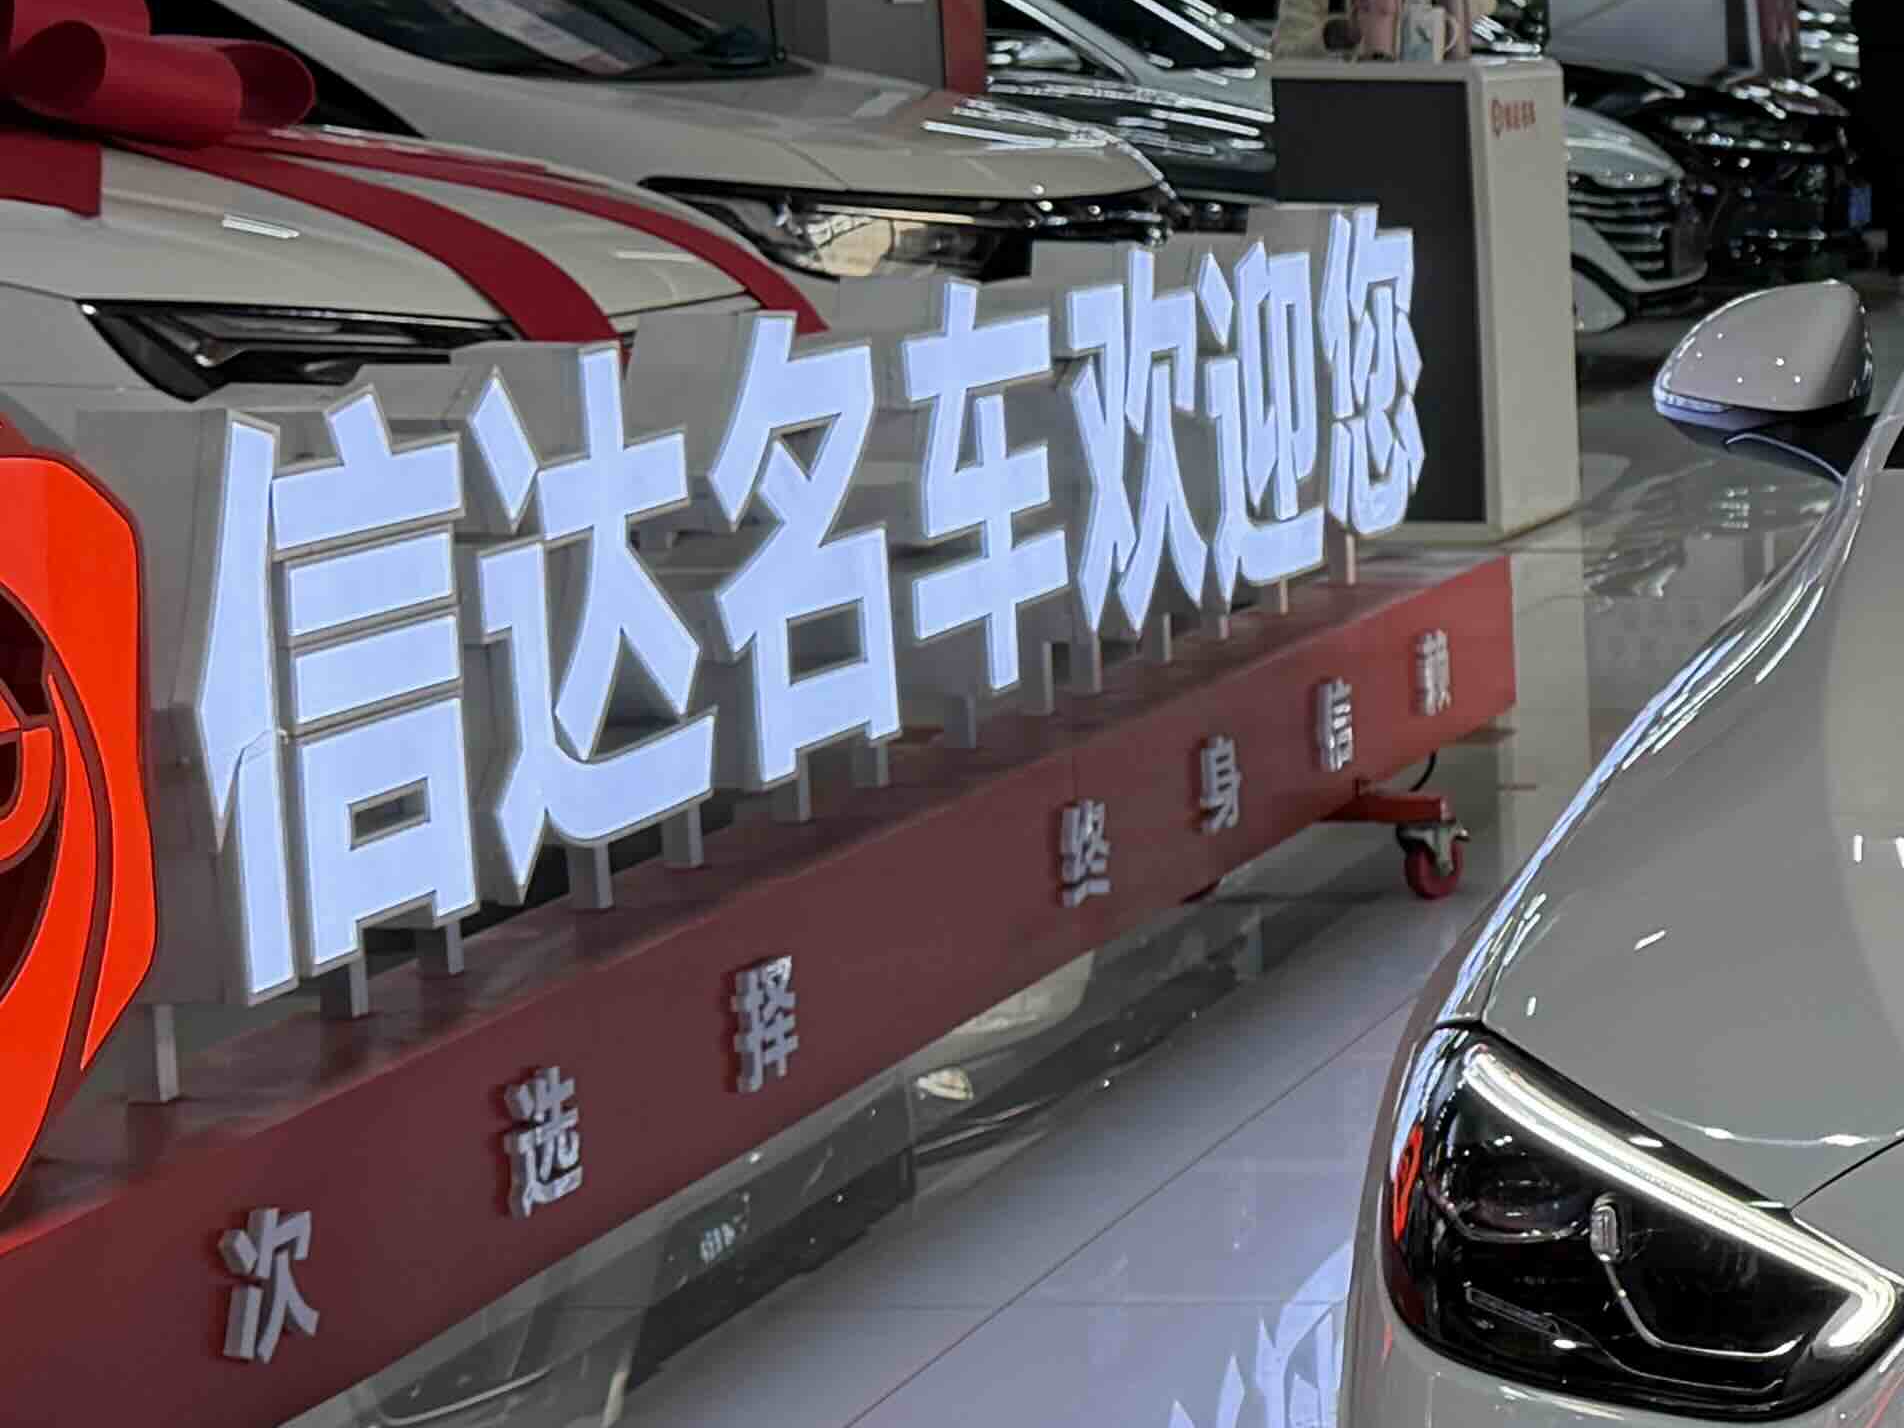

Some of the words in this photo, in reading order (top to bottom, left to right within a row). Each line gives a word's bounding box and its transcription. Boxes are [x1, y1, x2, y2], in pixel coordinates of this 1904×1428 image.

[199, 205, 1424, 999] 信达名车欢迎您
